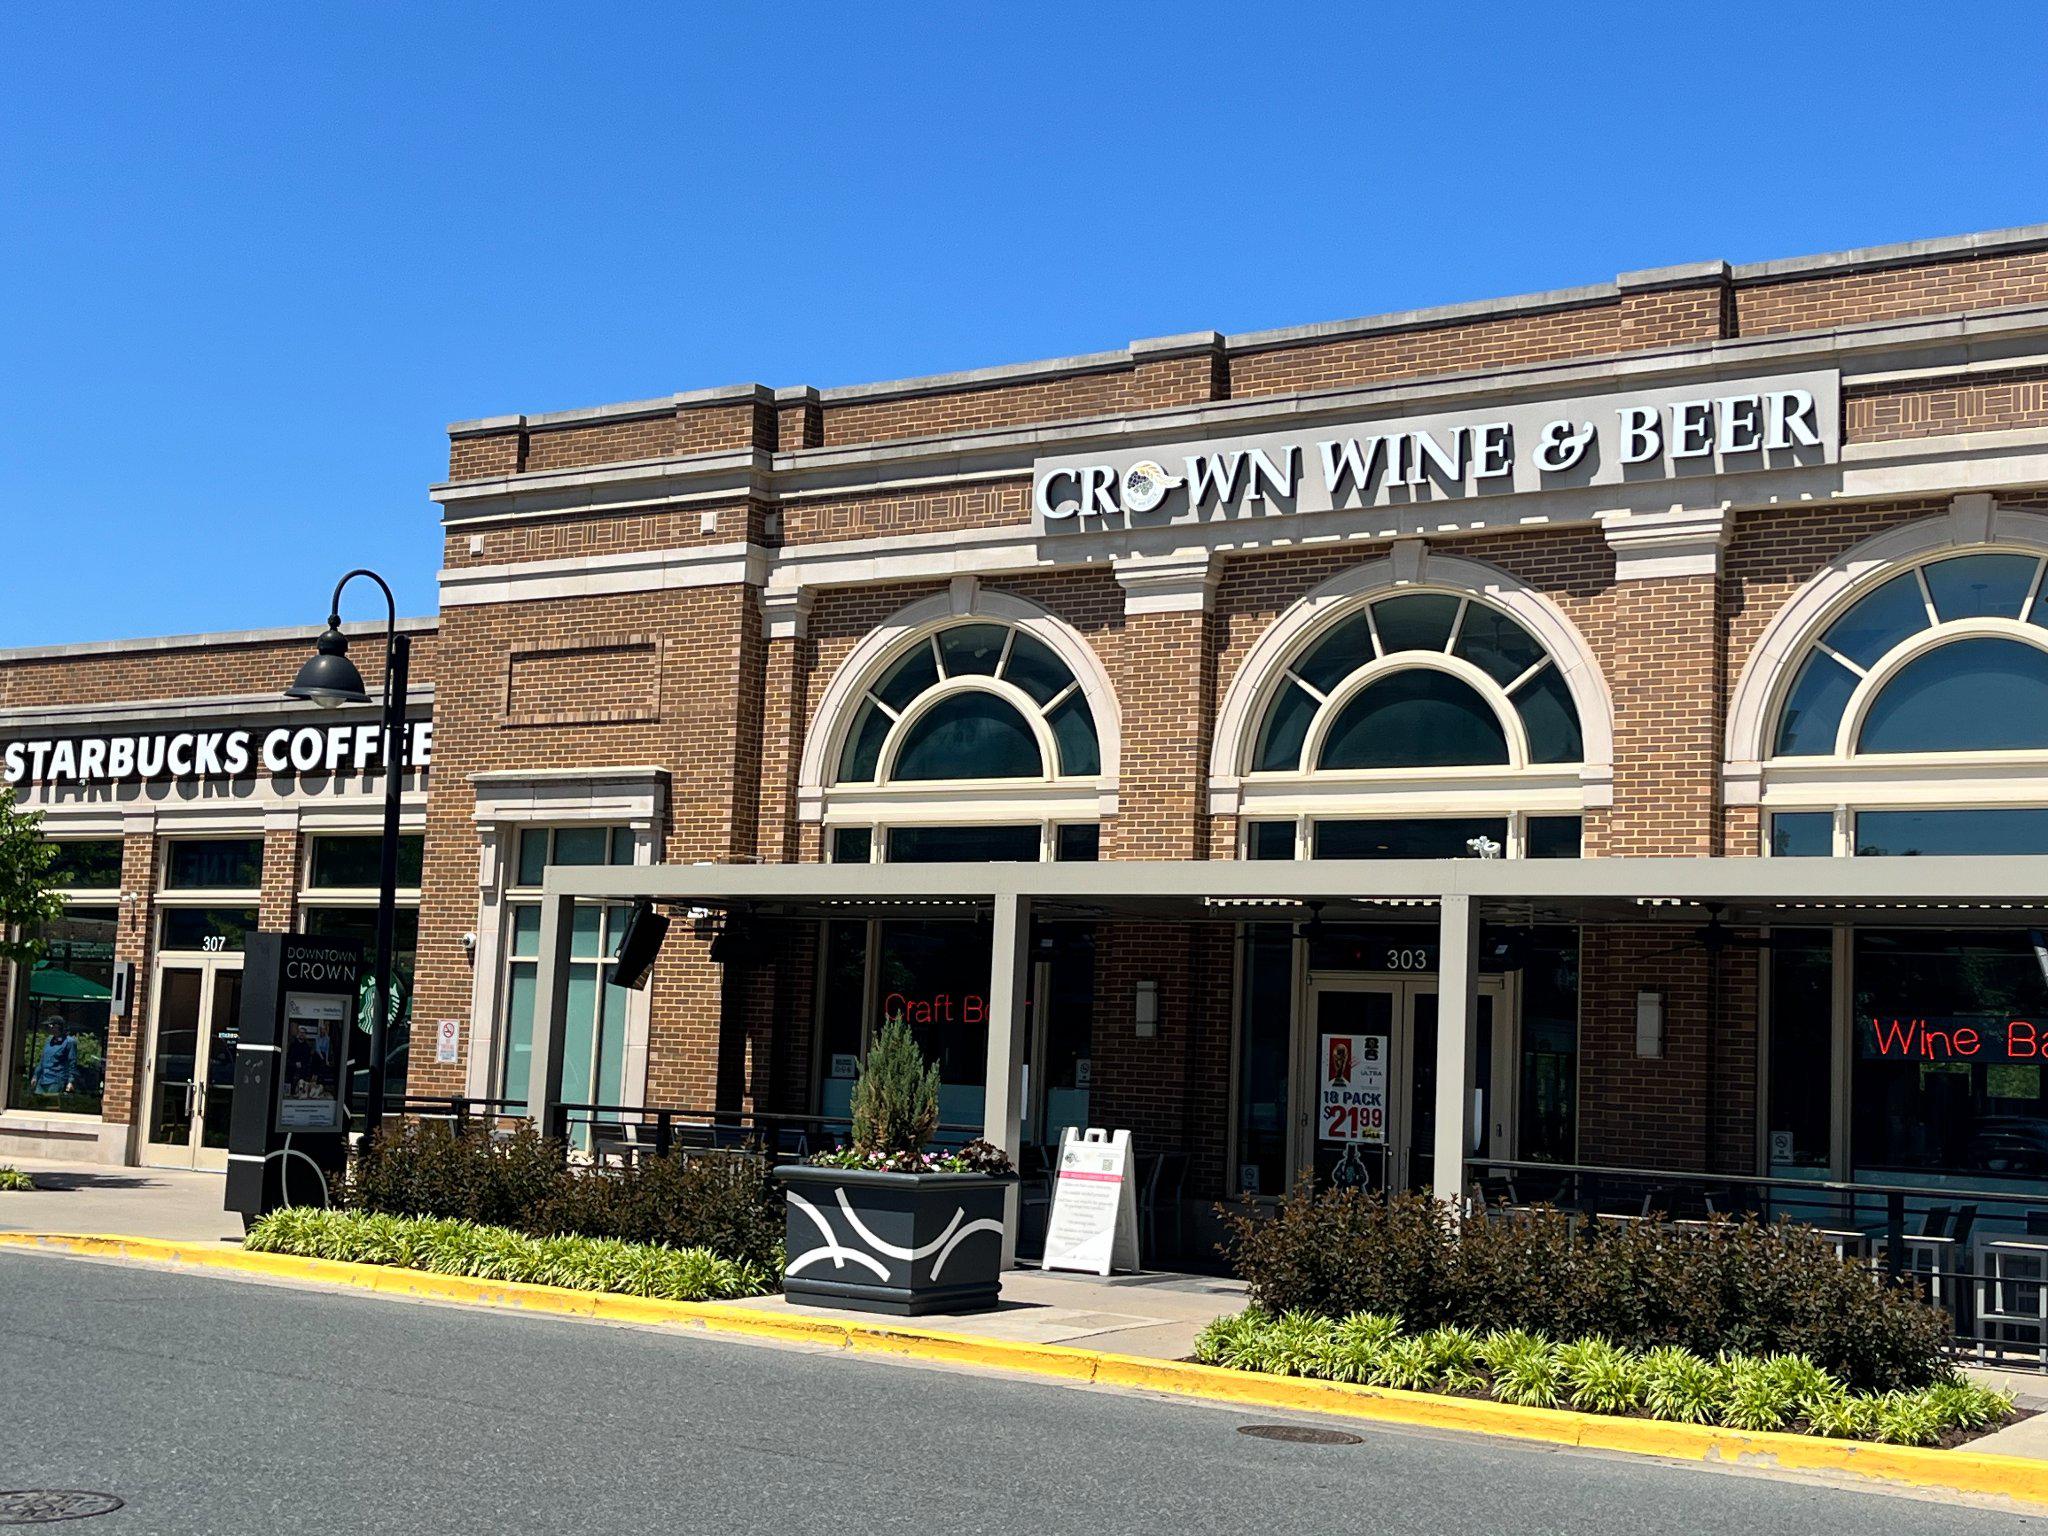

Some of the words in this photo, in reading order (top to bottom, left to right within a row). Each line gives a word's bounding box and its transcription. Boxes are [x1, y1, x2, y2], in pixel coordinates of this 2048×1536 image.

[1317, 421, 1513, 493] WINE
[1532, 420, 1597, 472] &
[1615, 388, 1823, 464] BEER
[3, 730, 251, 782] STARBUCKS
[202, 936, 226, 952] 307
[287, 946, 357, 962] DOWNTOWN
[1387, 949, 1427, 969] 303
[286, 961, 357, 981] CROWN
[885, 993, 955, 1022] Craft
[1873, 1018, 1981, 1060] Wine
[2008, 1021, 2048, 1059] B
[1323, 1091, 1340, 1104] 18
[1343, 1091, 1383, 1107] PACK
